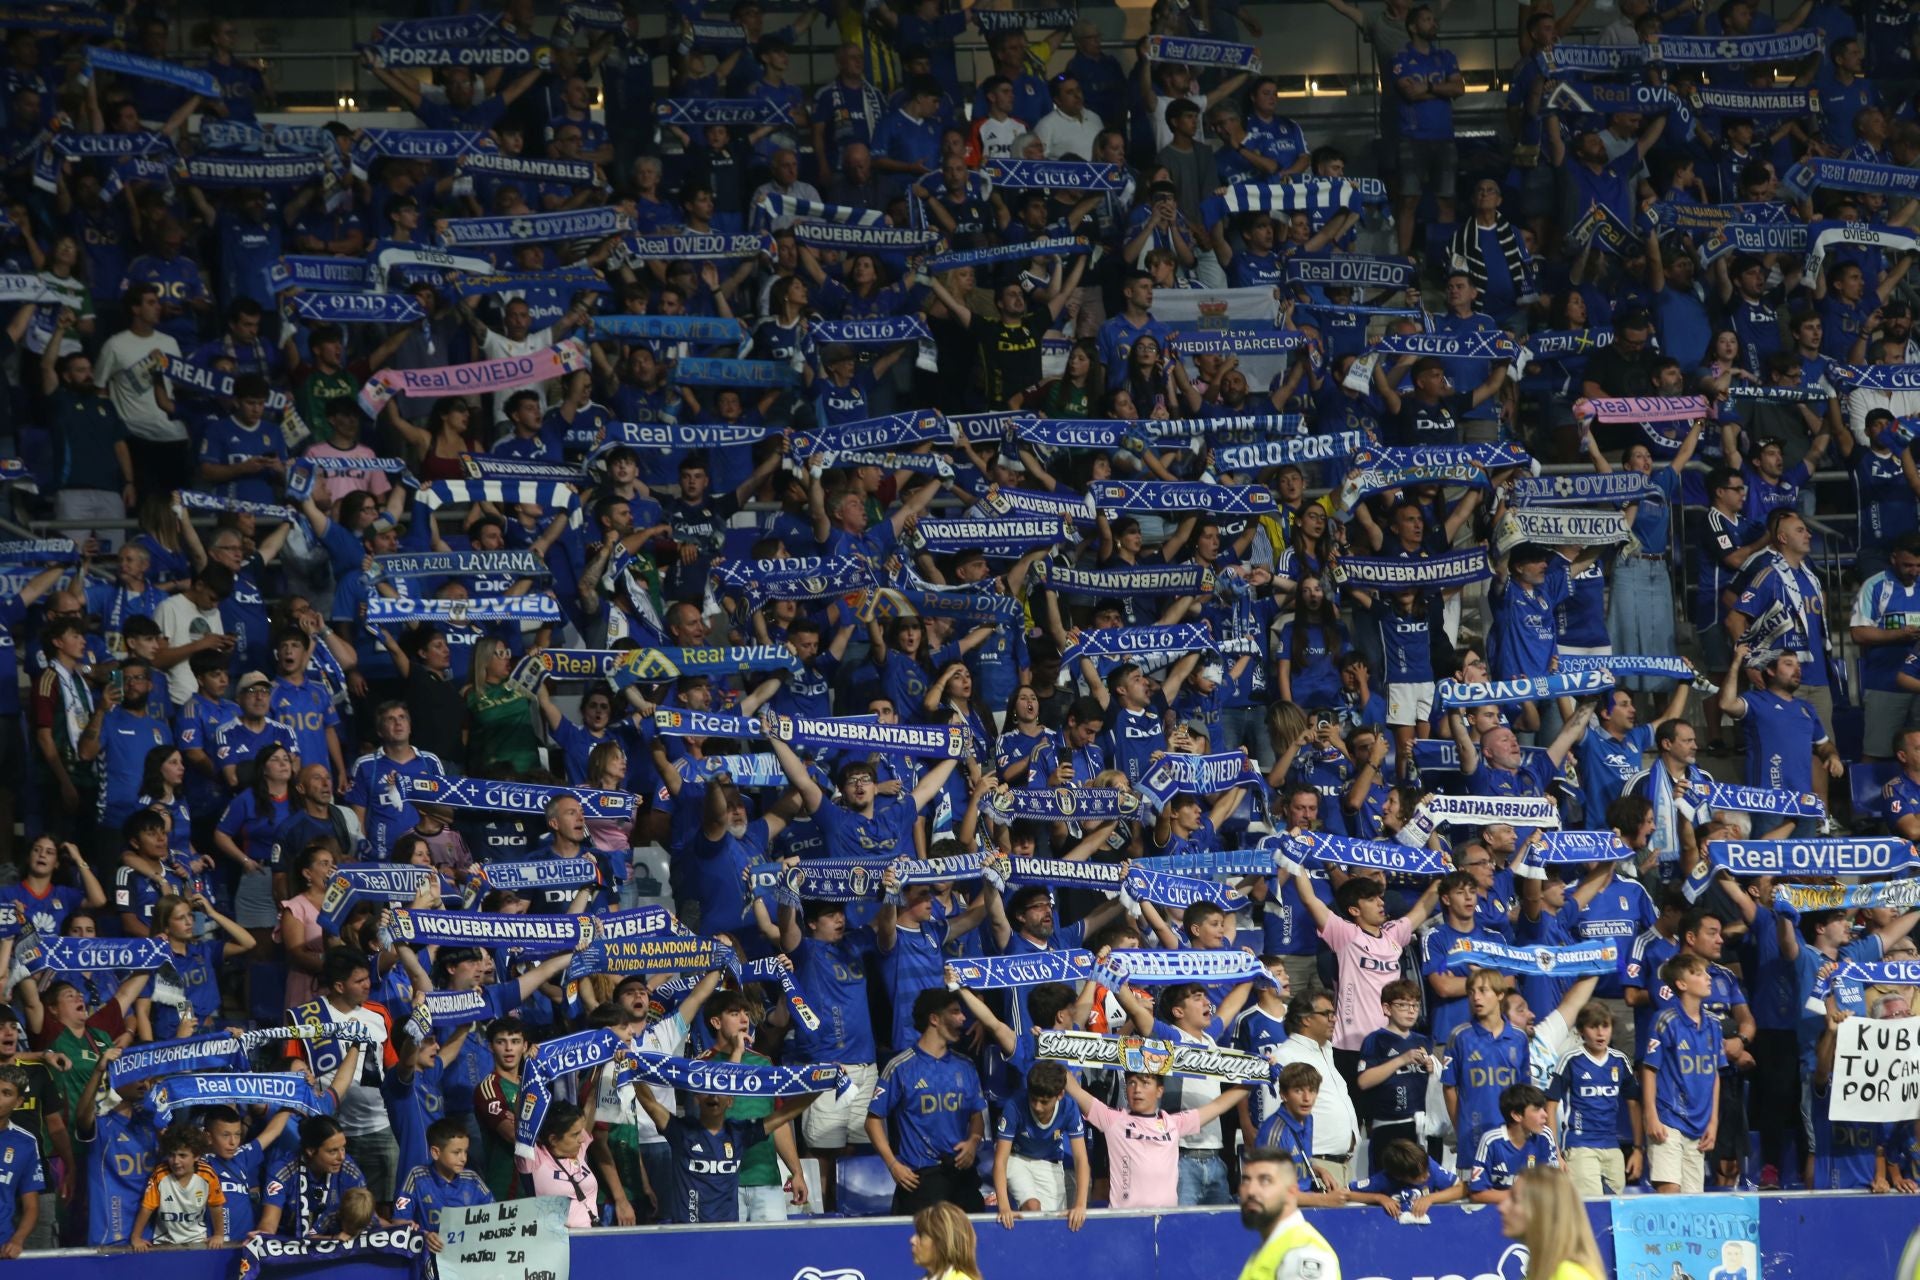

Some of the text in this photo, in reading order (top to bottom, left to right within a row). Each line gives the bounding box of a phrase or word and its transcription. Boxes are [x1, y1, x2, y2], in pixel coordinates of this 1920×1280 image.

[416, 26, 468, 42] CICLO
[1166, 40, 1184, 58] Real
[1185, 42, 1221, 62] OVIEDO
[1664, 31, 1816, 60] REAL OVIEDO
[389, 48, 530, 65] FORZA OVIEDO
[1554, 50, 1608, 67] OVIEDO
[1593, 86, 1630, 101] Real
[1702, 90, 1806, 109] INQUEBRANTABLES
[704, 107, 756, 122] CICLO
[78, 136, 132, 151] CICLO
[396, 137, 448, 154] CICLO
[1034, 171, 1081, 186] CICLO
[1821, 165, 1919, 188] 1926 OVIEDO Real
[457, 213, 614, 241] REAL OVIEDO
[1843, 229, 1880, 243] OVIEDO
[638, 236, 762, 254] Real OVIEDO 1926
[1736, 228, 1809, 248] Real OVIED
[416, 250, 454, 265] OVIEDO
[296, 264, 363, 281] Real OVIEDO
[1300, 261, 1403, 283] Real OVIEDO
[331, 295, 386, 311] CICLO
[842, 323, 893, 339] CICLO
[1406, 337, 1460, 354] CICLO
[1539, 336, 1575, 352] REAL
[171, 360, 217, 392] REAL
[404, 358, 534, 388] Real OVIEDO
[1594, 395, 1708, 415] Real OVIEDO
[624, 422, 767, 443] Real OVIEDO
[841, 428, 888, 449] CICLO
[1055, 430, 1115, 445] CICLO
[1222, 430, 1361, 468] SOLO POR TI
[1412, 450, 1473, 467] CICLO
[1364, 466, 1406, 488] REAL
[1575, 473, 1654, 494] OVIEDO
[1161, 490, 1212, 508] CICLO
[922, 520, 1059, 539] INQUEBRANTABLES
[1568, 513, 1628, 536] OVIEDO
[388, 553, 536, 572] PEÑA AZUL LAVIANA
[758, 556, 821, 572] CICLO
[1346, 555, 1485, 582] INQUEBRANTABLES
[1051, 566, 1198, 590] INQUEBRANTABLES
[923, 594, 970, 610] Real
[1118, 631, 1174, 650] CICLO
[557, 652, 596, 673] Real
[683, 646, 725, 663] Real
[790, 680, 828, 695] DIGI
[1438, 679, 1531, 700] OVIEDO
[691, 712, 740, 733] Real
[1125, 722, 1161, 740] DIGI
[798, 720, 945, 748] INQUEBRANTABLES
[1172, 753, 1242, 782] REAL OVIEDO
[1074, 789, 1093, 798] REAL
[1736, 790, 1776, 809] CICLO
[488, 836, 527, 847] DIGI
[790, 837, 823, 852] DIGI
[1565, 836, 1596, 850] CICLO
[1351, 846, 1405, 867] CICLO
[1728, 843, 1891, 868] Real OVIEDO
[489, 862, 595, 885] REAL OVIEDO
[802, 868, 850, 879] REAL OVIEDO
[1016, 856, 1123, 881] INQUEBRANTAB
[361, 870, 390, 890] Real
[417, 914, 576, 939] INQUEBRANTABLES
[1581, 924, 1634, 936] ASTURIANA
[78, 947, 134, 966] CICLO
[605, 940, 712, 957] YO NO ABANDONÉ AL
[1473, 939, 1601, 963] PEÑA AZUL SOMIEDO
[608, 954, 711, 969] R.OVIEDO HACIA PRIMERA
[1122, 951, 1252, 977] REAL OVIEDO
[1009, 964, 1053, 982] CICLO
[428, 992, 486, 1016] INQUEBRANTABLES
[549, 1044, 600, 1073] CICLO
[1038, 1033, 1270, 1082] Siempre Carbayón
[1678, 1054, 1718, 1074] DIGI
[1840, 1055, 1878, 1078] TU
[196, 1076, 296, 1097] Real OVIEDO
[687, 1072, 762, 1092] CICLO
[1469, 1066, 1516, 1088] DIGI
[1580, 1086, 1620, 1097] DIGI
[1843, 1081, 1890, 1102] POR
[920, 1094, 964, 1115] DIGI
[688, 1160, 741, 1173] DIGI
[1631, 1212, 1760, 1238] COLOMBATTO
[447, 1230, 465, 1244] 21
[507, 1250, 525, 1263] ZA
